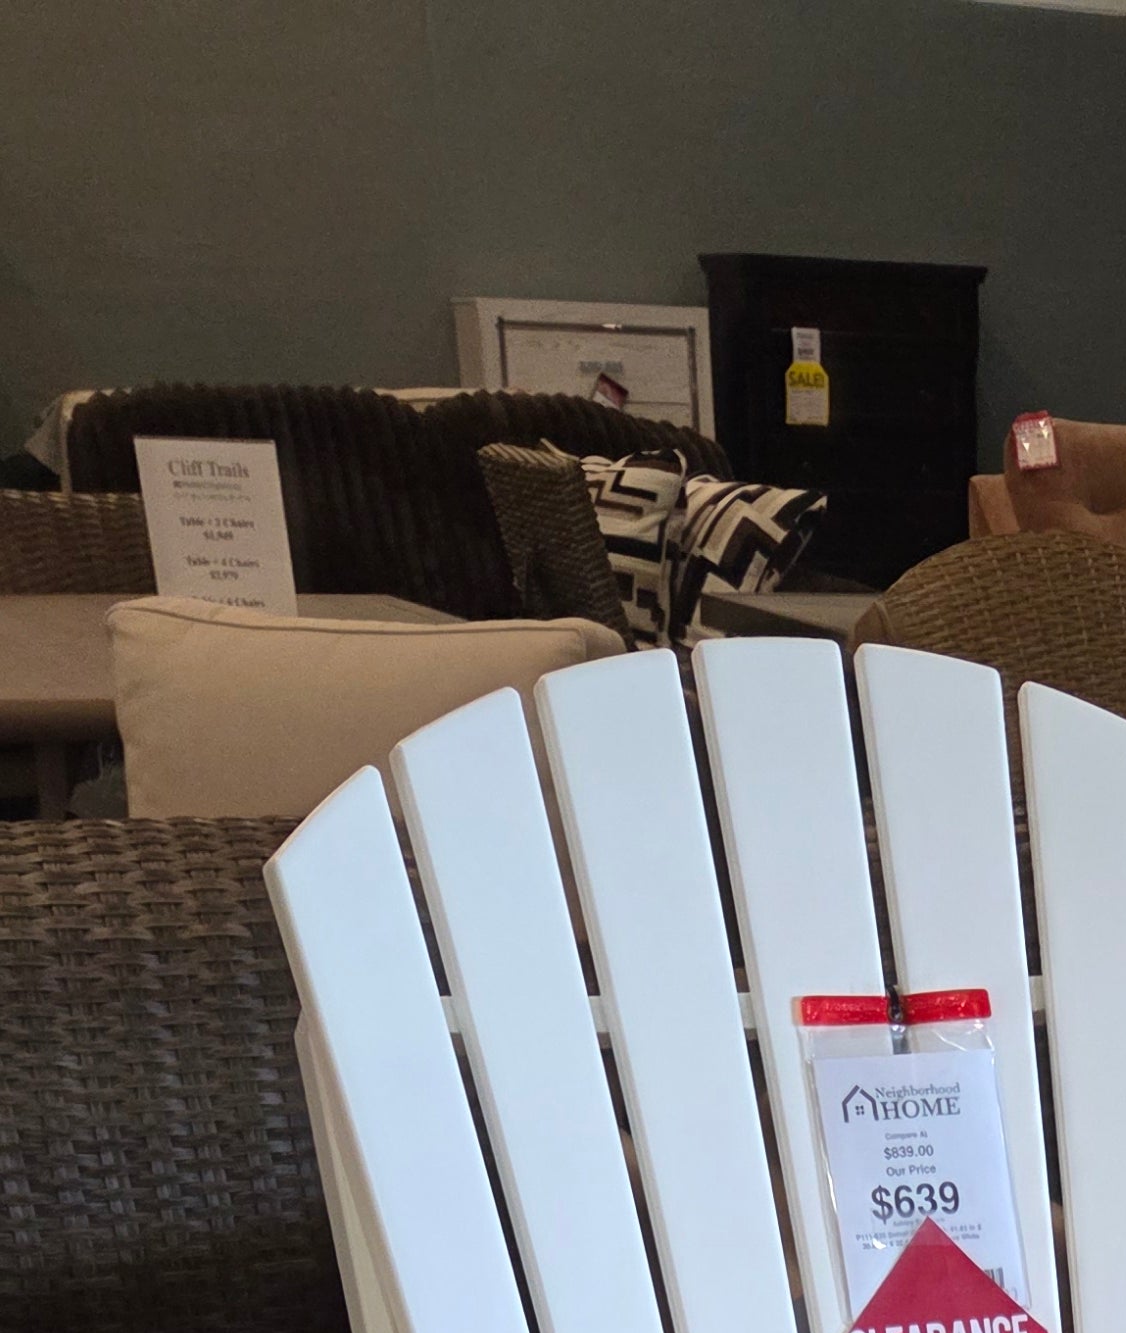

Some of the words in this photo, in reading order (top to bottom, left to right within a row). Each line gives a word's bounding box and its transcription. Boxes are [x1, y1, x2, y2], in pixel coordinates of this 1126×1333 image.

[168, 460, 202, 477] Cliff
[207, 460, 250, 478] Trails
[875, 1082, 960, 1099] Neighborhood
[880, 1096, 961, 1120] HOME
[885, 1132, 917, 1141] Compare
[883, 1144, 934, 1161] $839.00
[886, 1166, 905, 1177] Our
[908, 1164, 937, 1176] Price
[871, 1181, 960, 1225] $639
